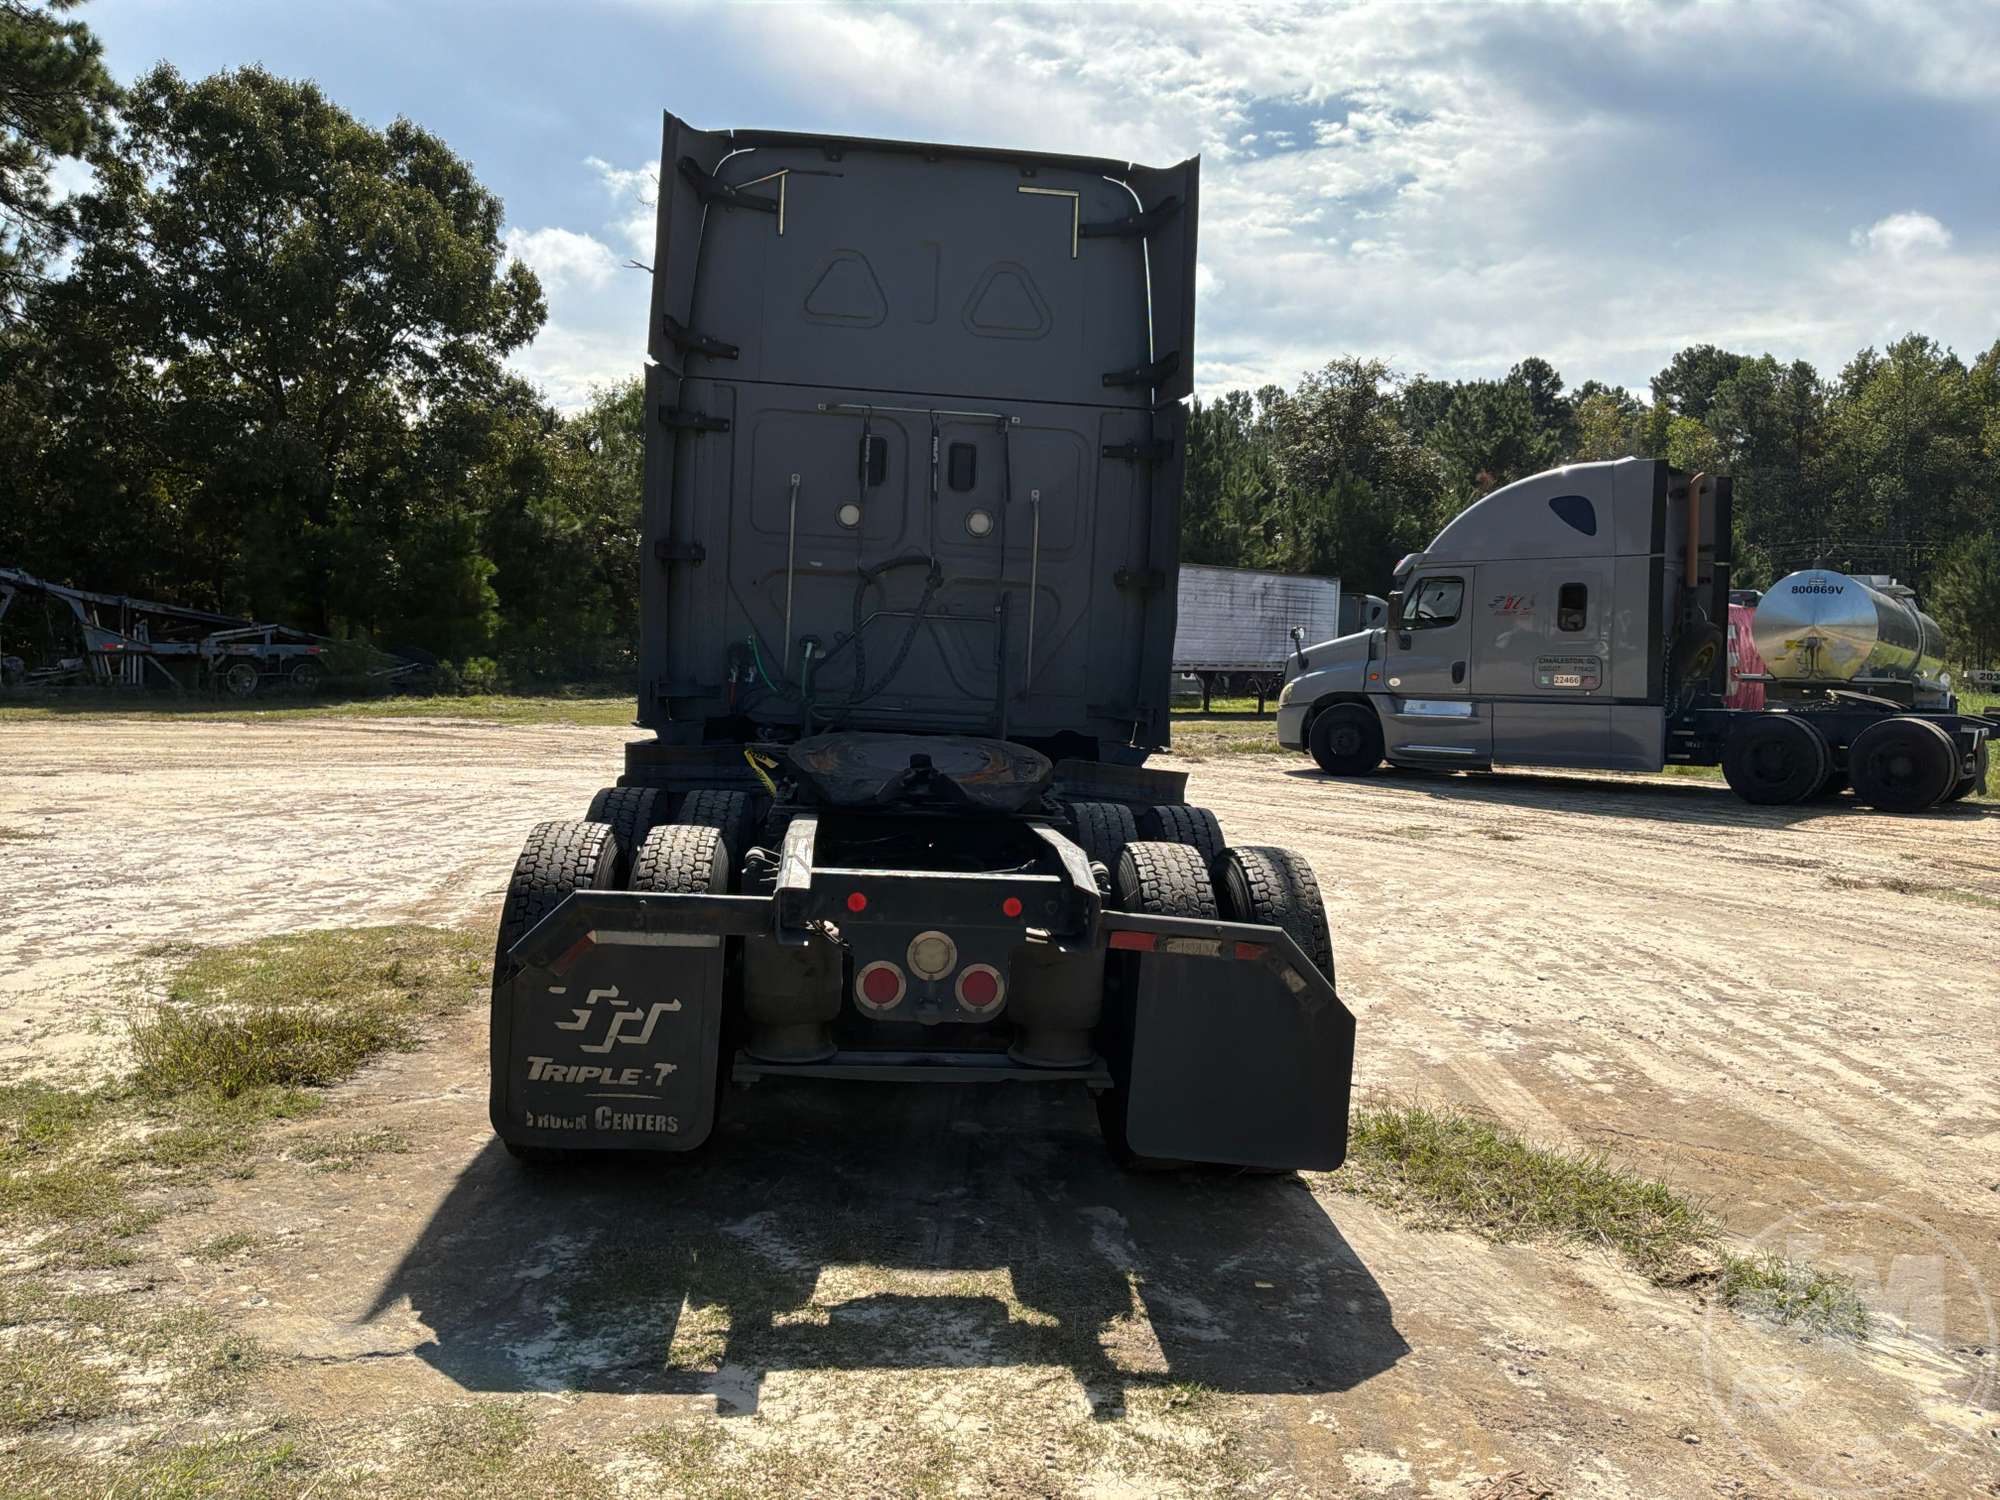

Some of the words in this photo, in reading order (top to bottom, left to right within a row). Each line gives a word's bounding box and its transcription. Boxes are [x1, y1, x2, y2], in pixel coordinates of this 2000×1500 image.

[1791, 585, 1844, 595] 800869V
[528, 1056, 677, 1086] TRIPLE-T
[595, 1106, 678, 1132] CENTERS
